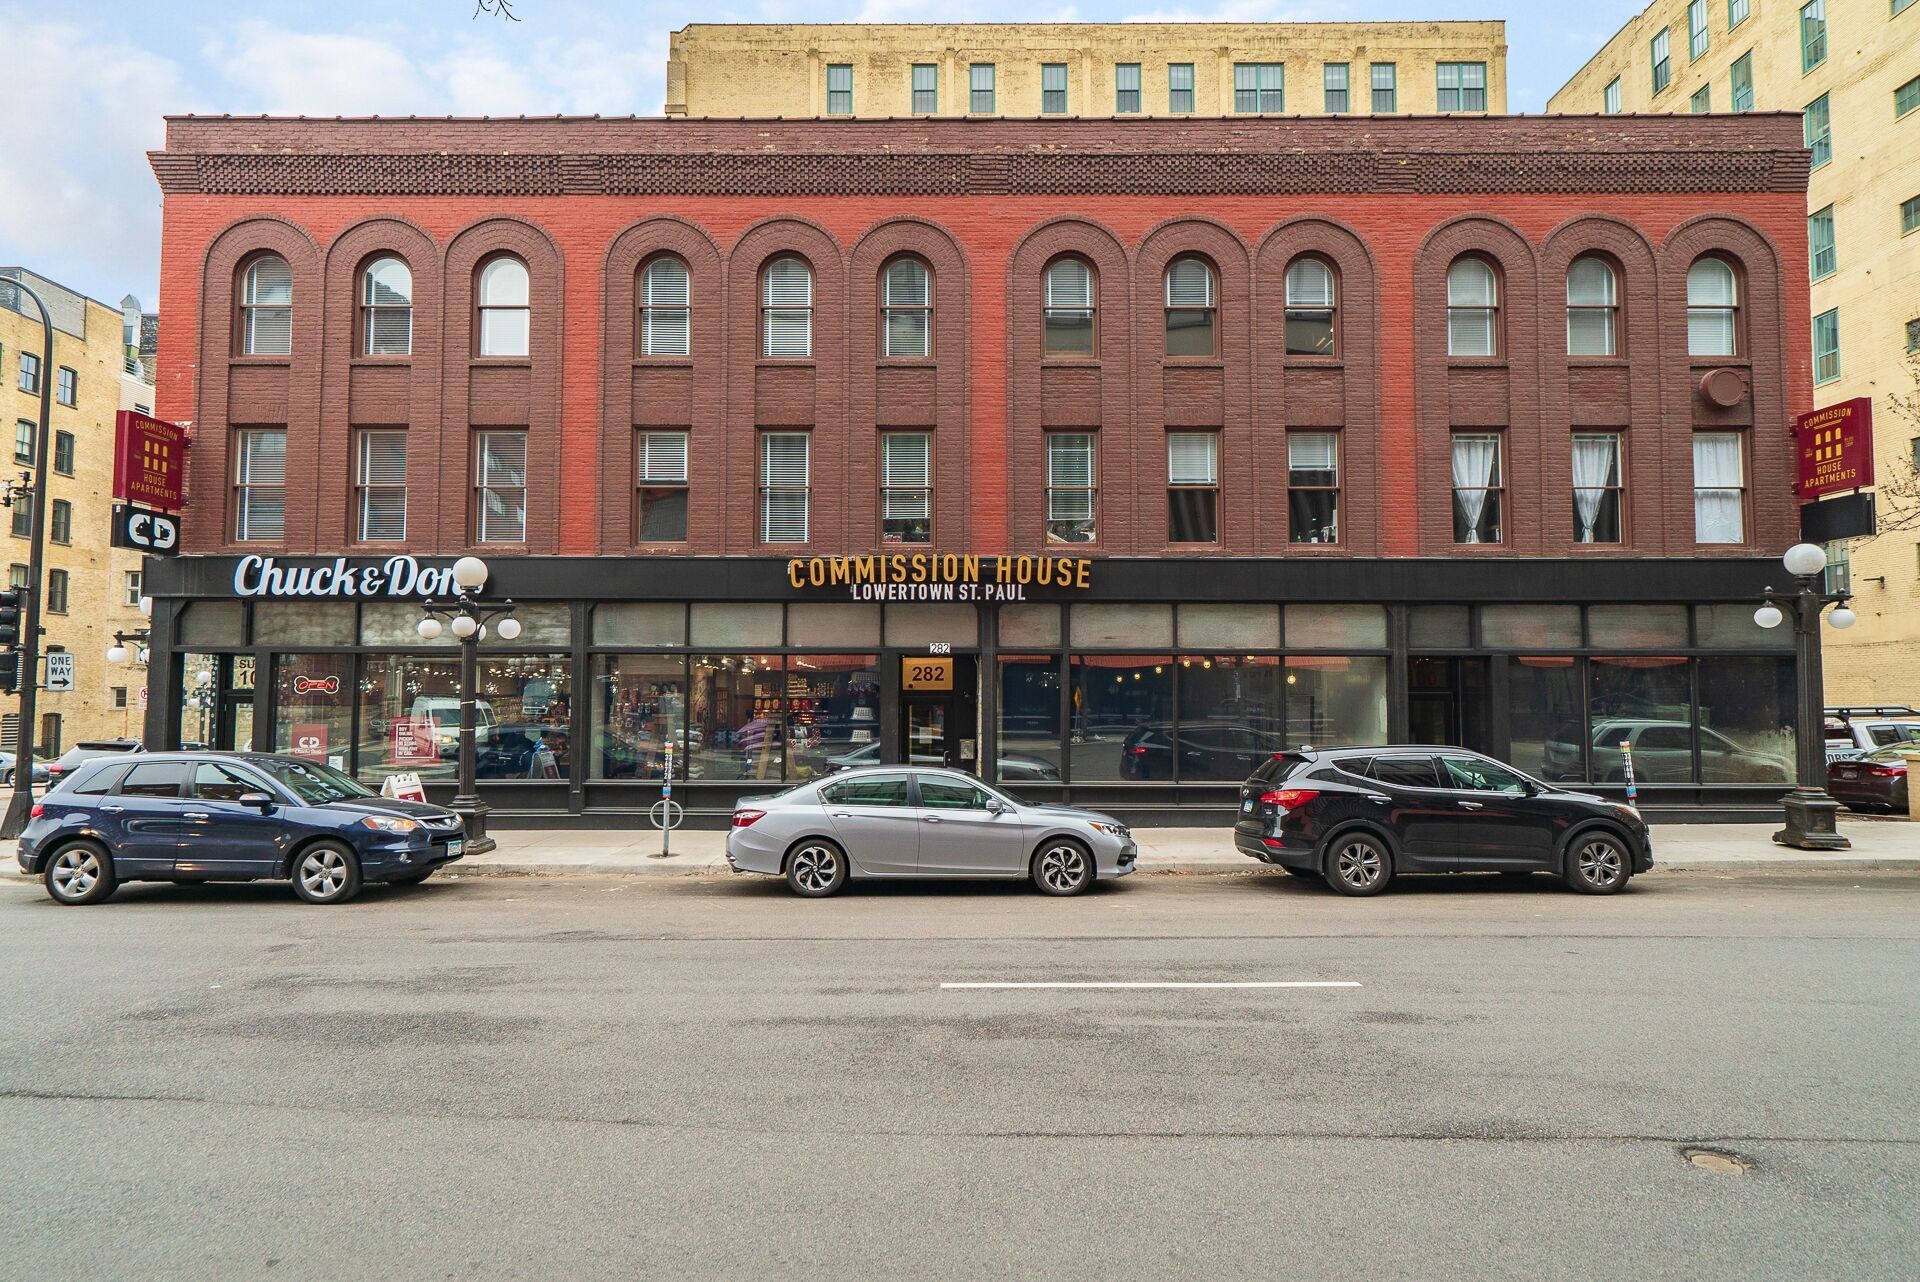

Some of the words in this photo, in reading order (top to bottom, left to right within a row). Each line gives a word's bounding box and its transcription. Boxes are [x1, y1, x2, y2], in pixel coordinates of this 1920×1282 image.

[1803, 408, 1852, 429] COMMISSION
[135, 420, 178, 441] COMMISSION
[1817, 461, 1842, 475] HOUSE
[143, 473, 166, 487] HOUSE
[1804, 468, 1856, 488] APARTMENTS
[130, 481, 177, 500] APARTMENTS
[233, 554, 359, 596] Chuck
[789, 553, 979, 588] COMMISSION
[996, 555, 1092, 588] HOUSE
[852, 584, 954, 600] LOWERTOWN
[958, 584, 982, 600] ST.
[985, 584, 1026, 600] PAUL
[930, 643, 950, 653] 282
[51, 656, 71, 665] ONE
[239, 659, 256, 669] SU
[51, 666, 72, 675] WAY
[911, 666, 945, 682] 282
[298, 681, 336, 690] OPEN
